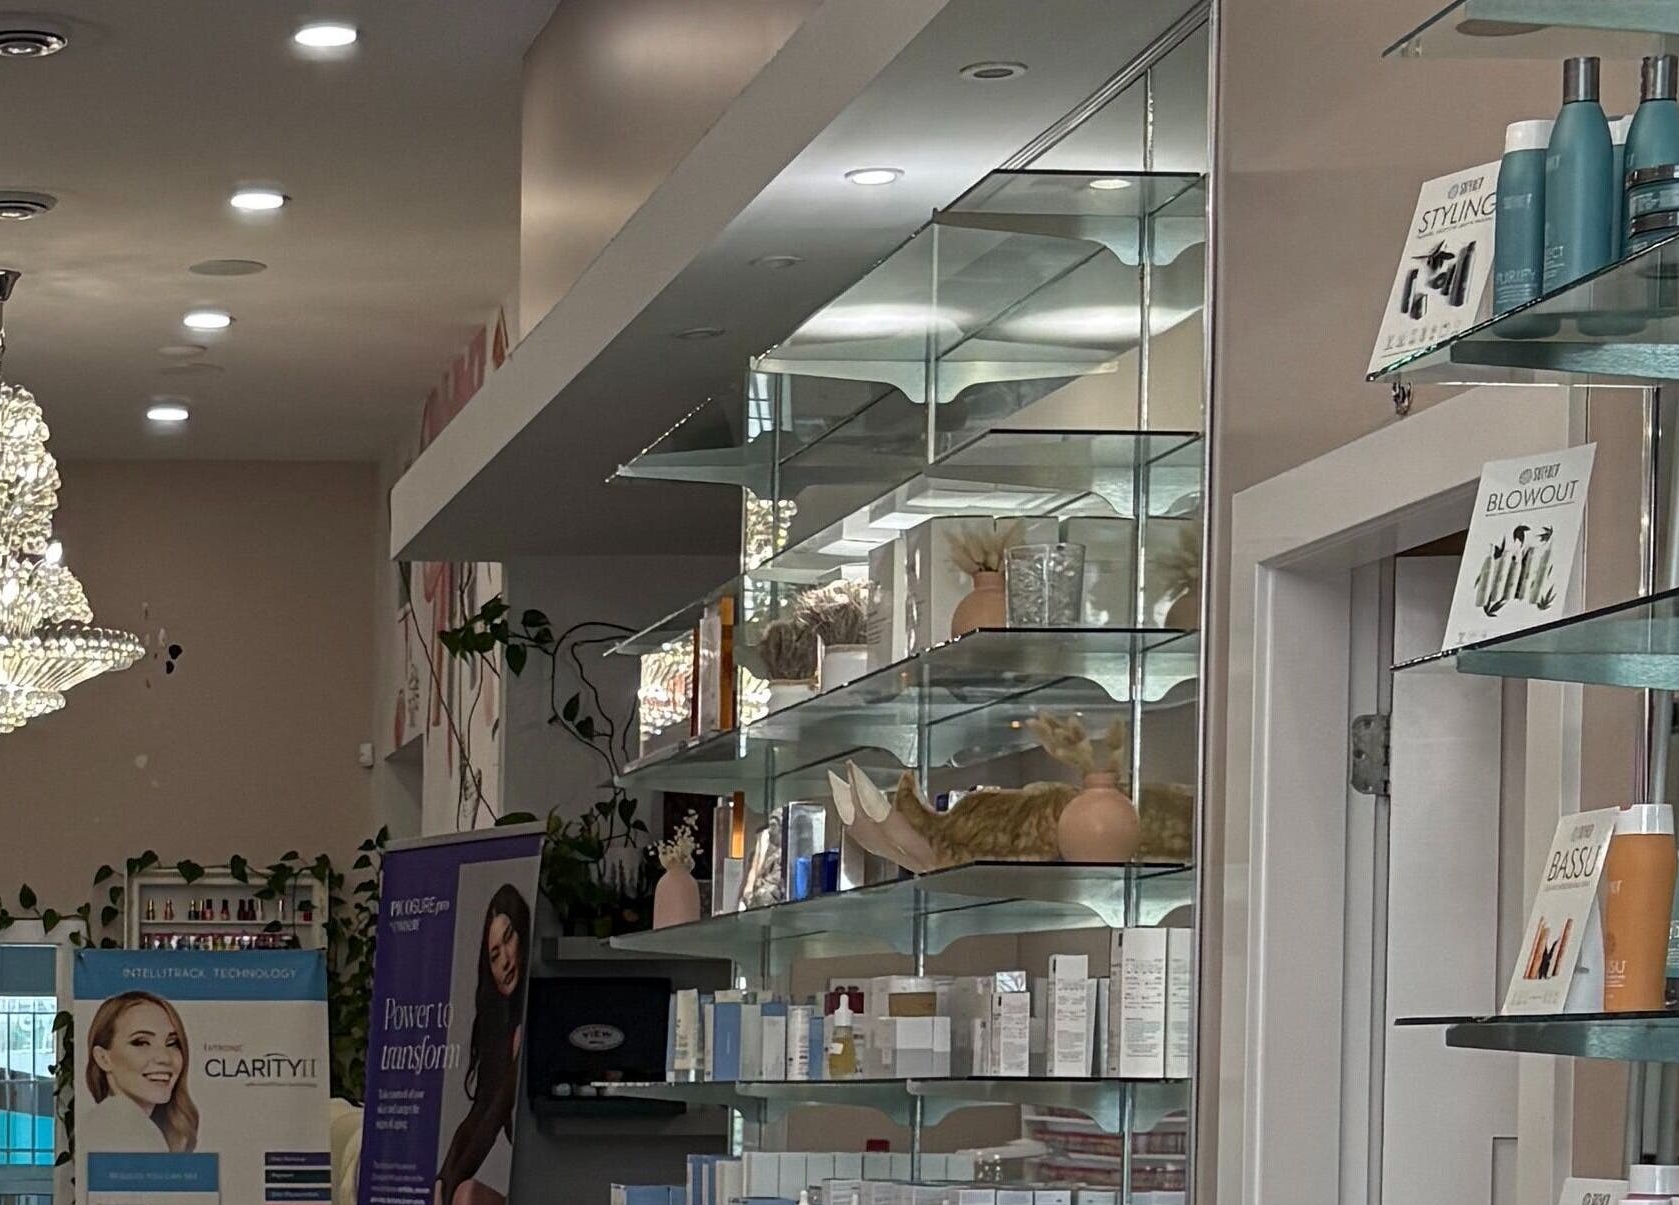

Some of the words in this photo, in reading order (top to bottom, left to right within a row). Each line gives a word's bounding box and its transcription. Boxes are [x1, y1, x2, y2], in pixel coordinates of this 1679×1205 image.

[1417, 190, 1498, 235] STYLING
[1486, 479, 1579, 513] BLOWOUT
[1547, 845, 1602, 882] BASSU
[214, 967, 297, 980] TECHNOLOGY
[384, 998, 435, 1031] Power
[437, 1002, 454, 1029] to
[381, 1034, 461, 1075] transform
